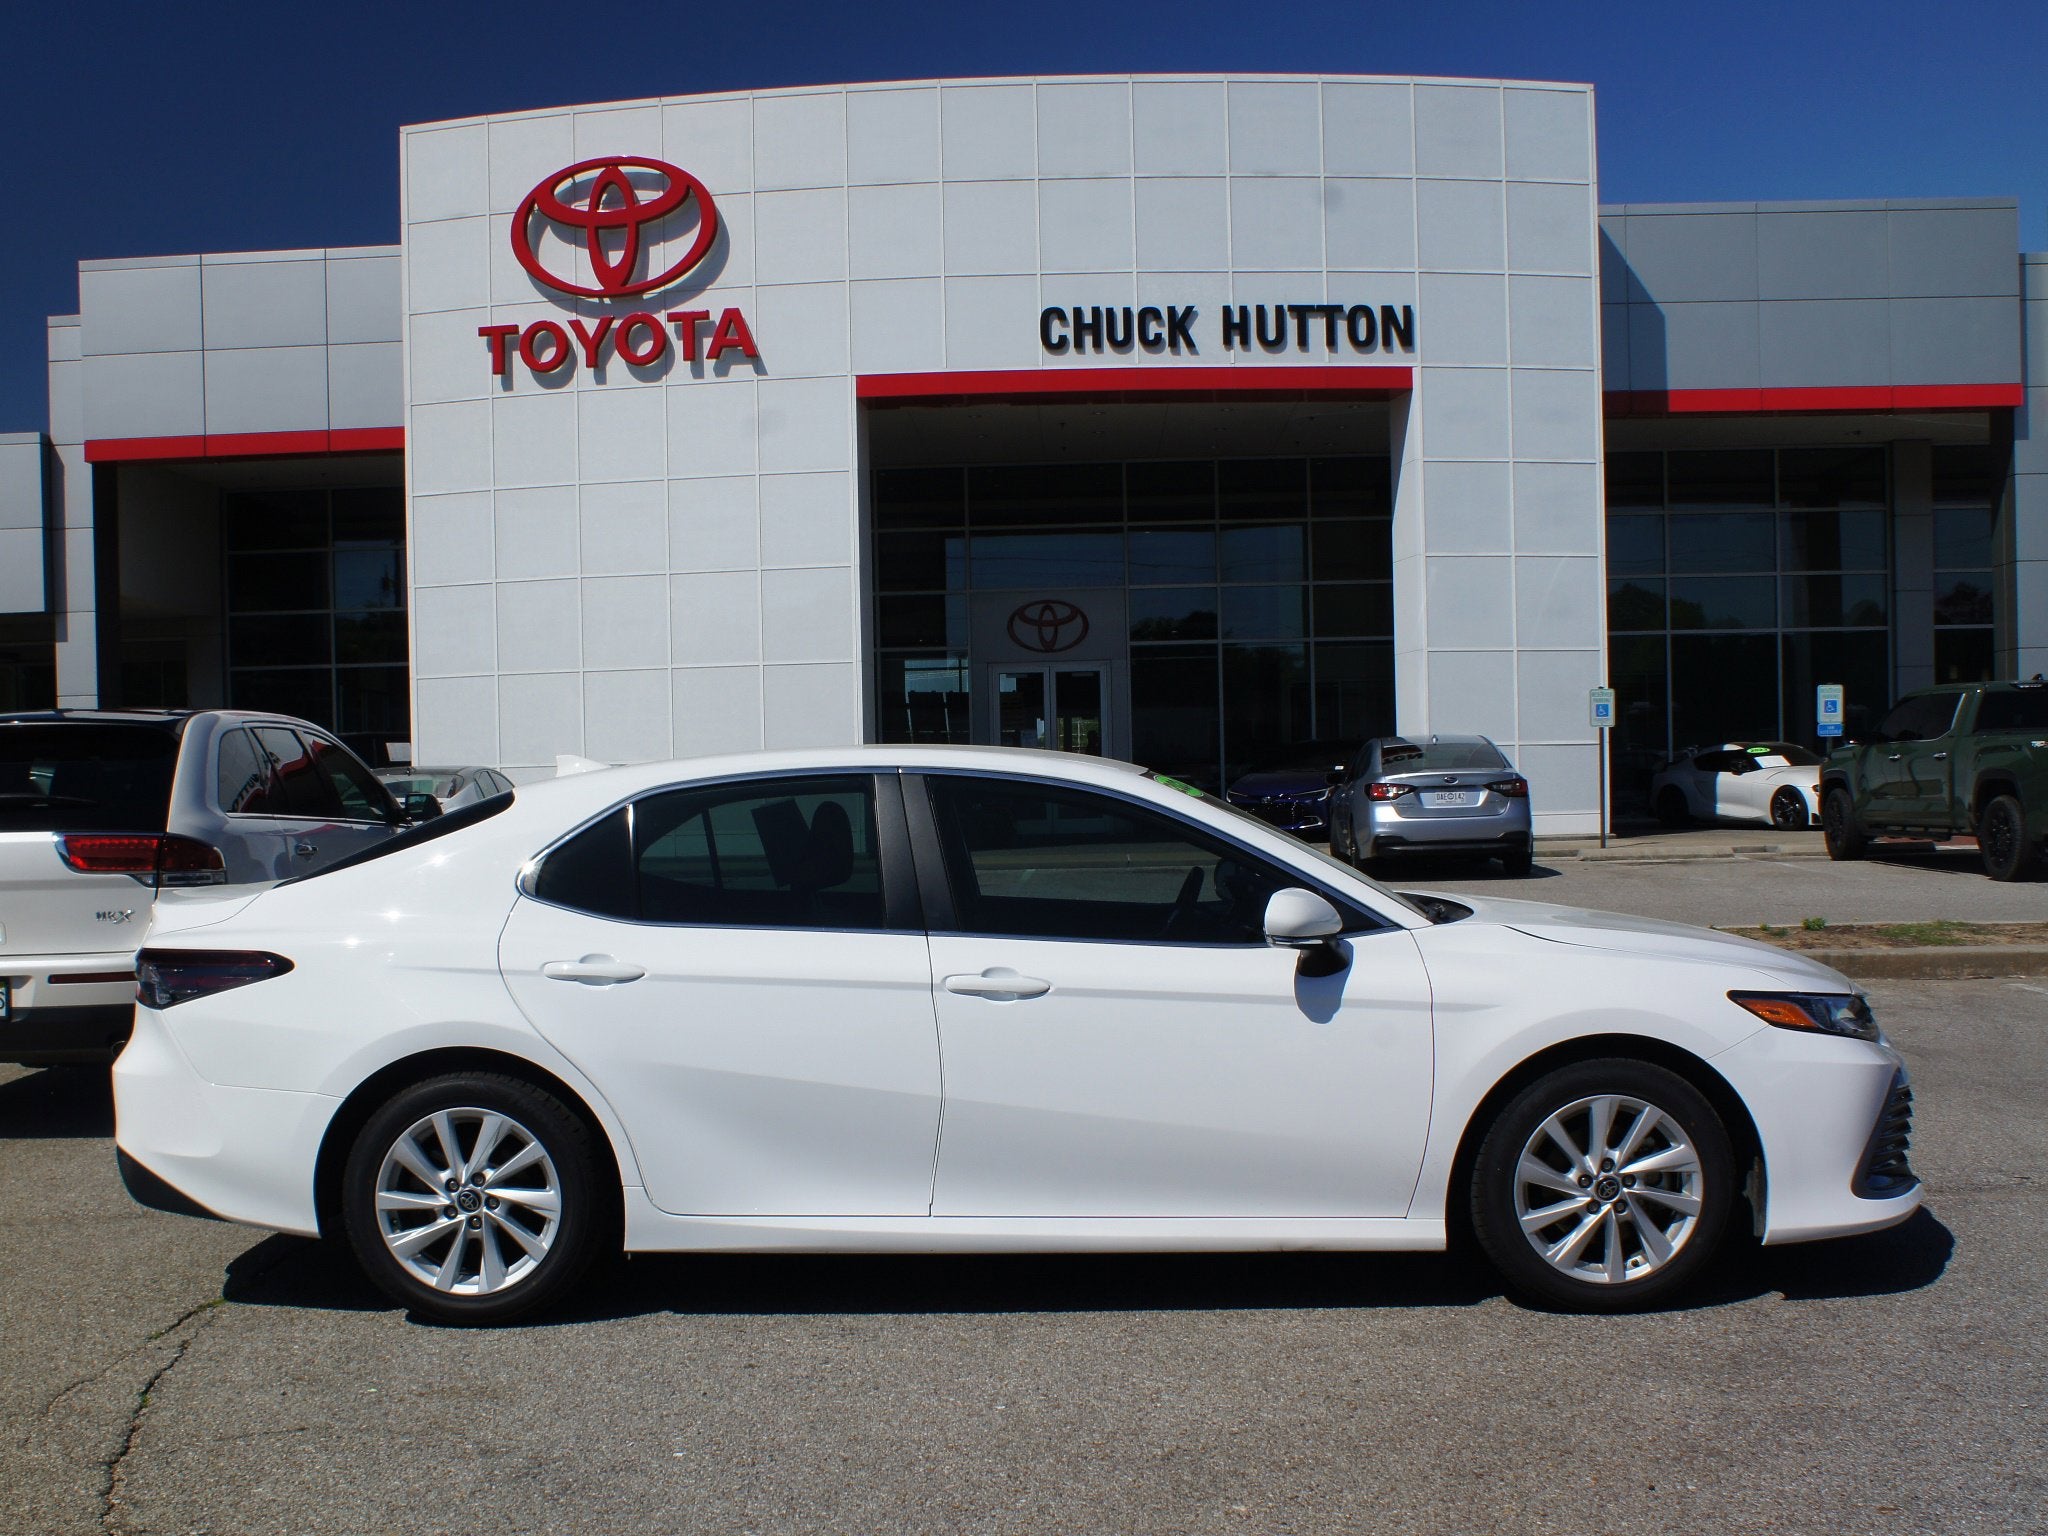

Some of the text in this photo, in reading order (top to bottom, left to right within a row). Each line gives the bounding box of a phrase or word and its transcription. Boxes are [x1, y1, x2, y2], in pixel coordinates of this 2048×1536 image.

[478, 307, 759, 375] TOYOTA
[1039, 304, 1413, 350] CHUCK HUTTON
